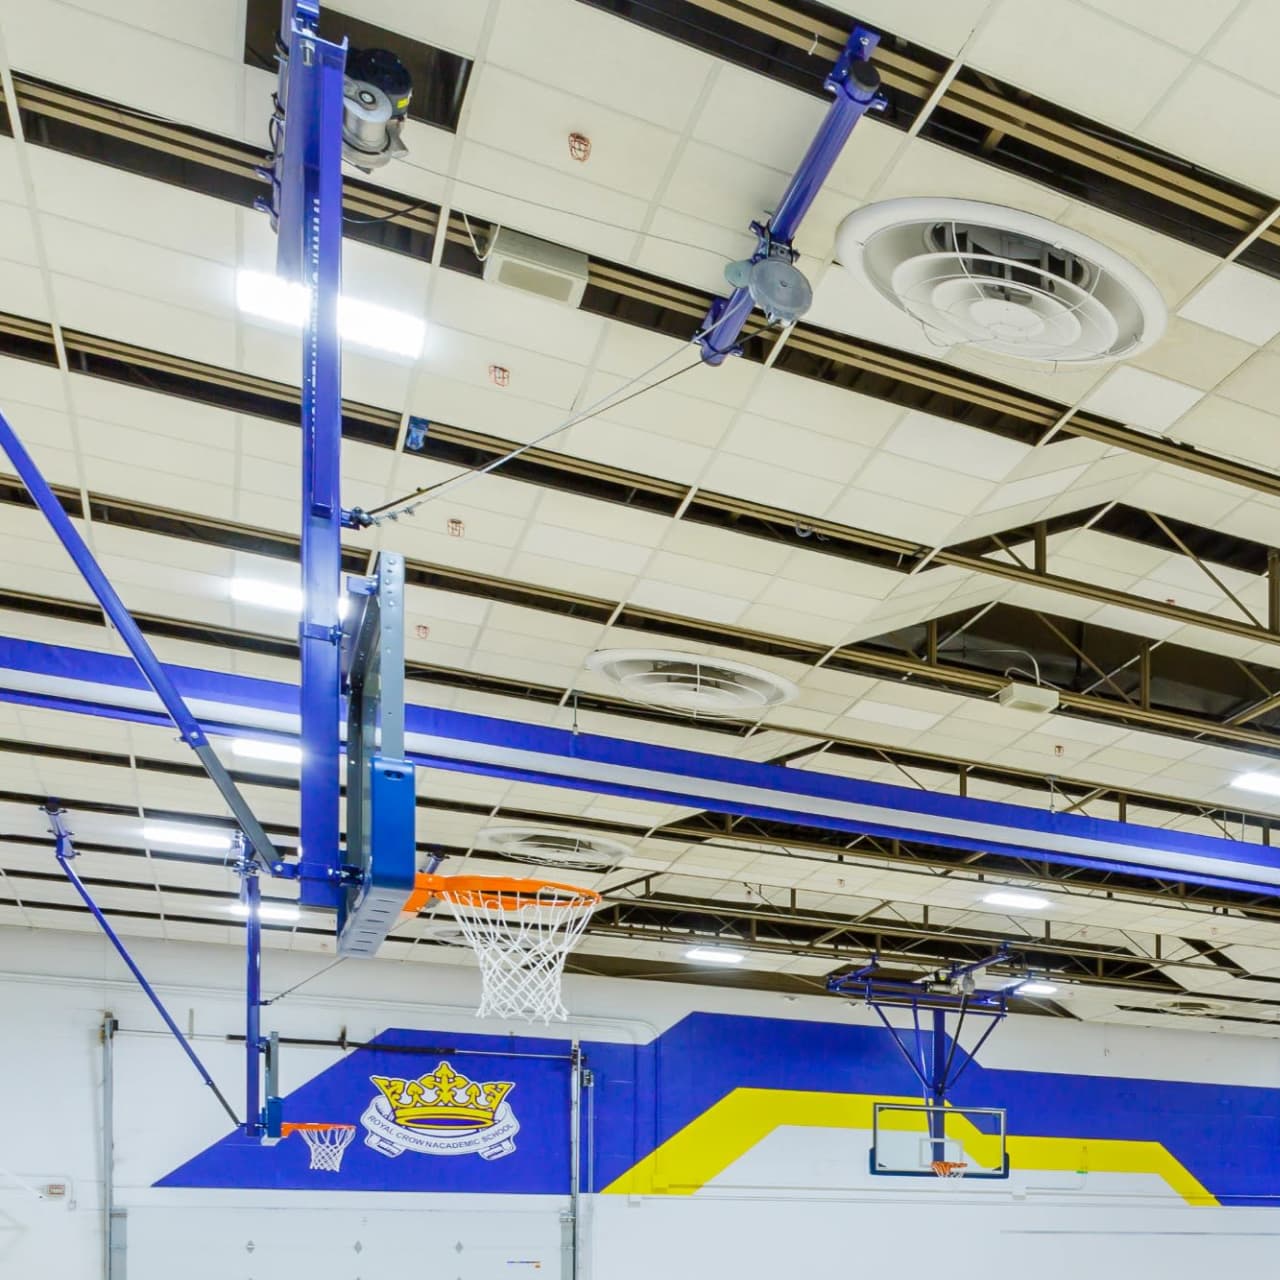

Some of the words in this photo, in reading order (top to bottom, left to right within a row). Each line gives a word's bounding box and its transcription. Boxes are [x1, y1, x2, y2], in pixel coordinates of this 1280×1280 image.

[367, 1115, 395, 1136] ROYAL
[395, 1131, 432, 1148] CROWN
[432, 1138, 480, 1149] ACADEMIC
[481, 1123, 513, 1143] SCHOOL
